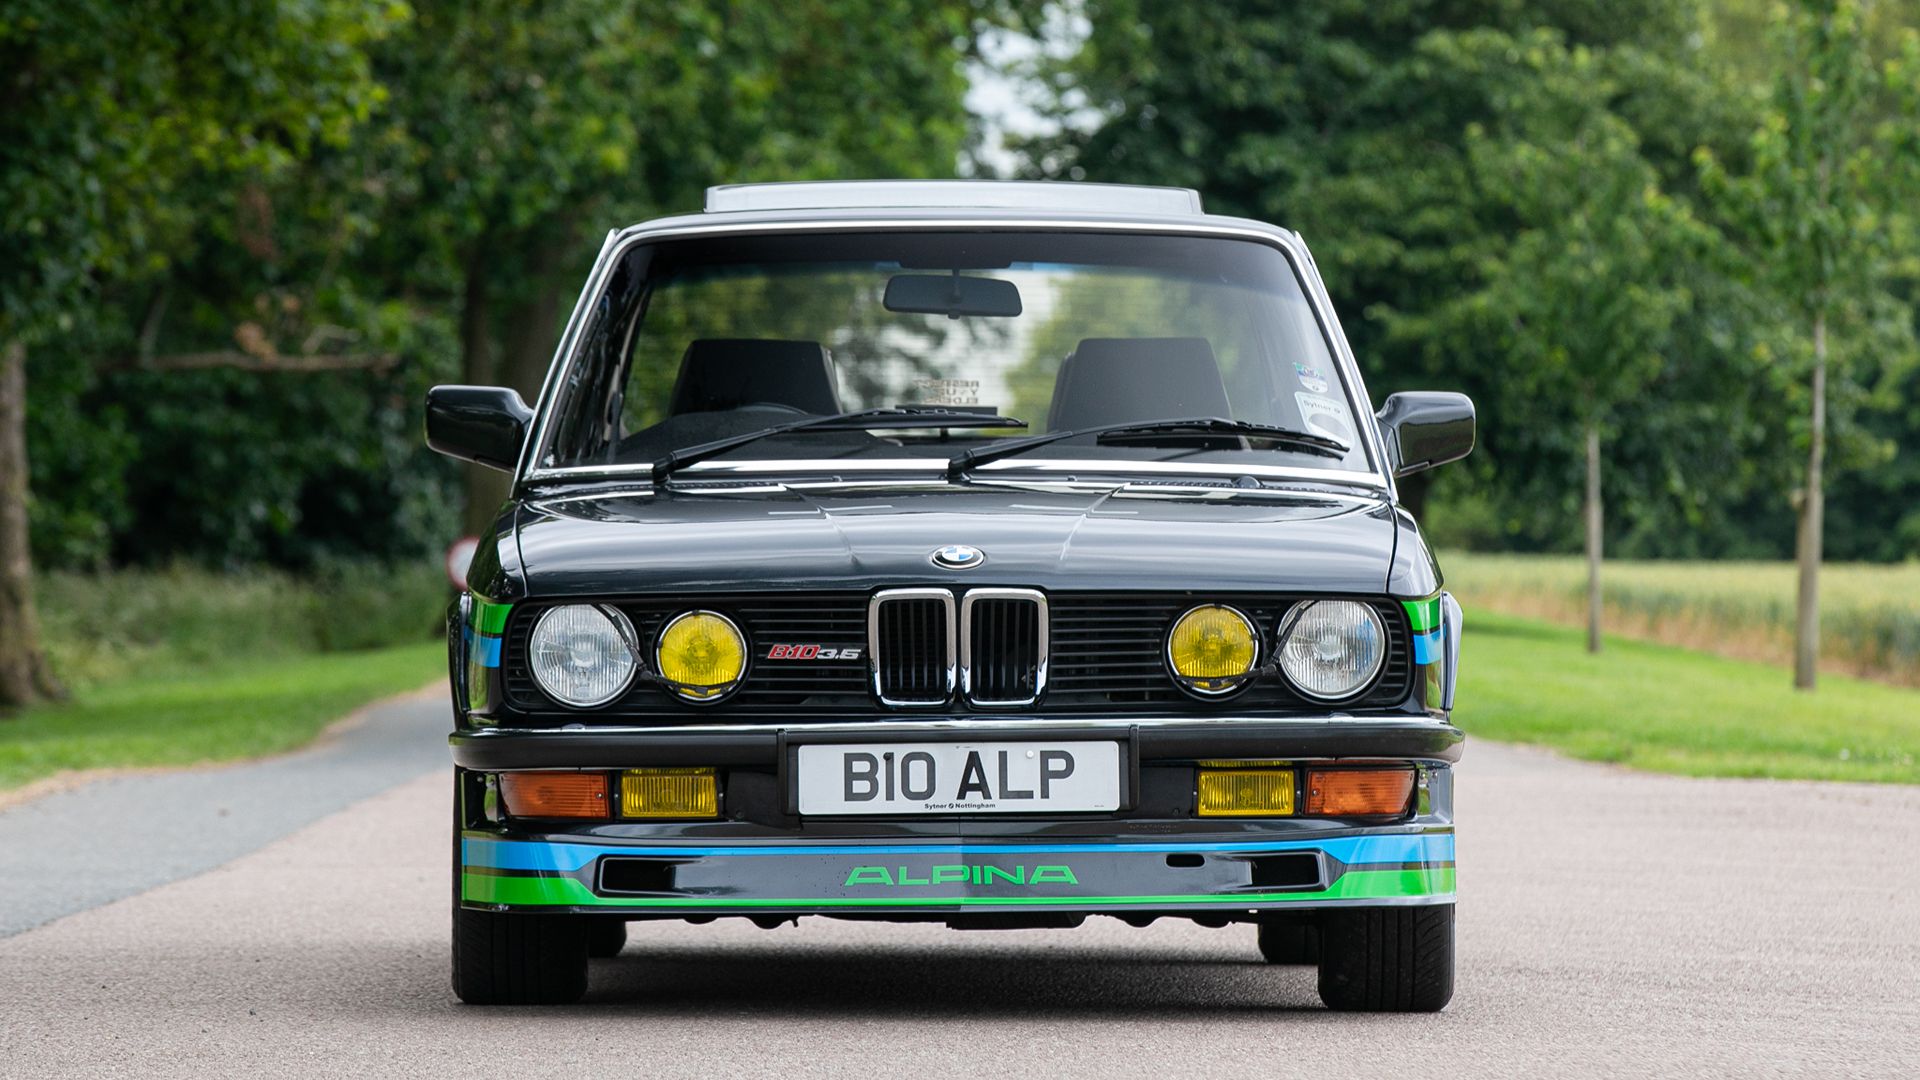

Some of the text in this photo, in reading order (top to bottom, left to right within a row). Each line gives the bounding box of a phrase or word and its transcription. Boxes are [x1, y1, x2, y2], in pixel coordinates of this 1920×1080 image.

[767, 644, 820, 660] B10
[844, 749, 1075, 801] B10 ALP
[955, 802, 996, 810] Nottingham
[844, 865, 1079, 886] ALPINA
